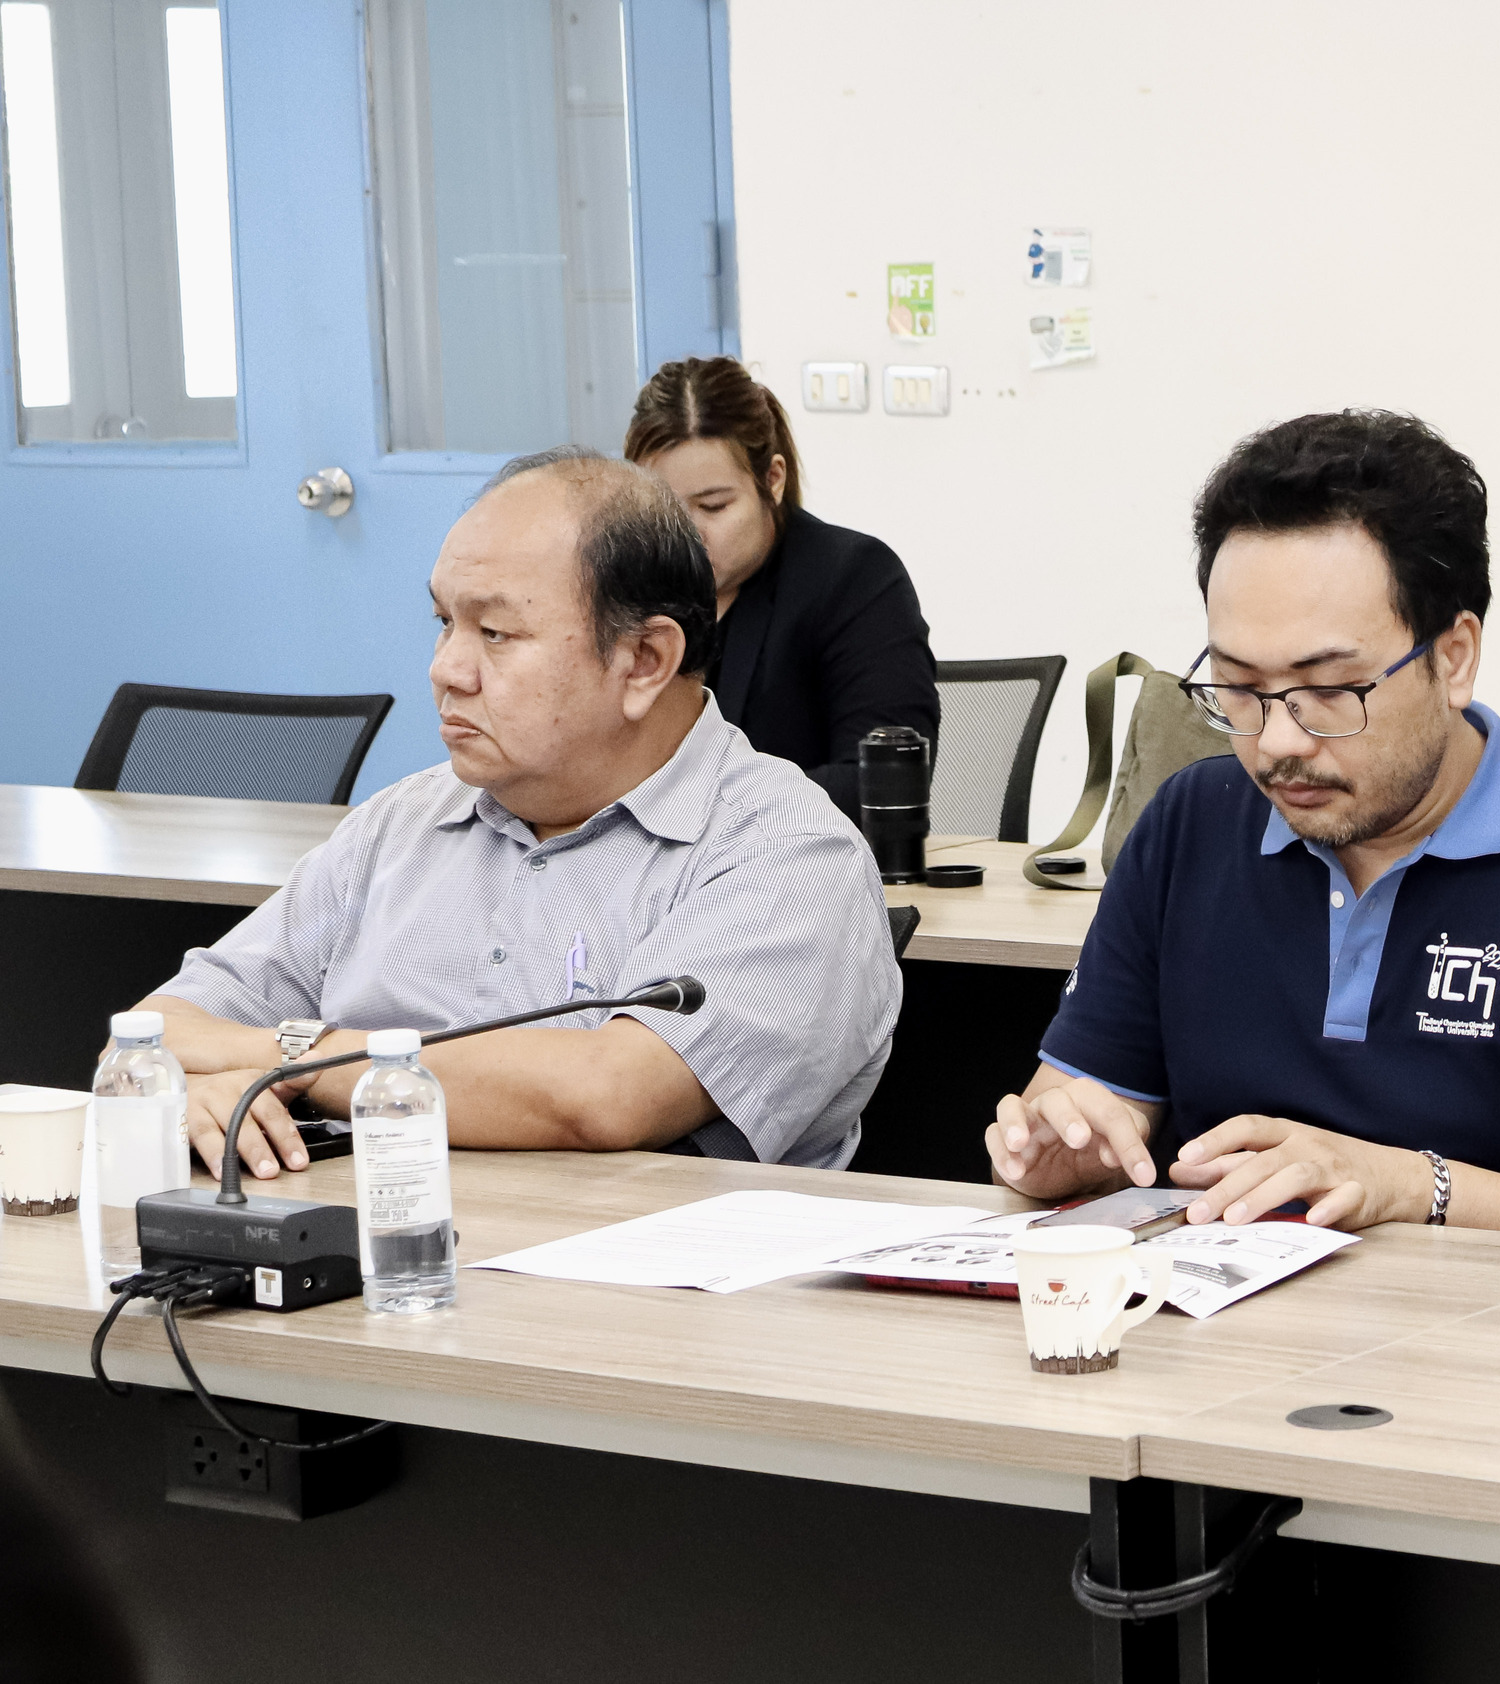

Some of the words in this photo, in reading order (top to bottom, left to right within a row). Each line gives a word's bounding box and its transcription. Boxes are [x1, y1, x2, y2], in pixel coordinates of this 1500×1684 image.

[1447, 1026, 1479, 1038] University
[245, 1225, 281, 1241] NPE
[1031, 1293, 1059, 1307] Street
[1061, 1291, 1091, 1311] Cafe
